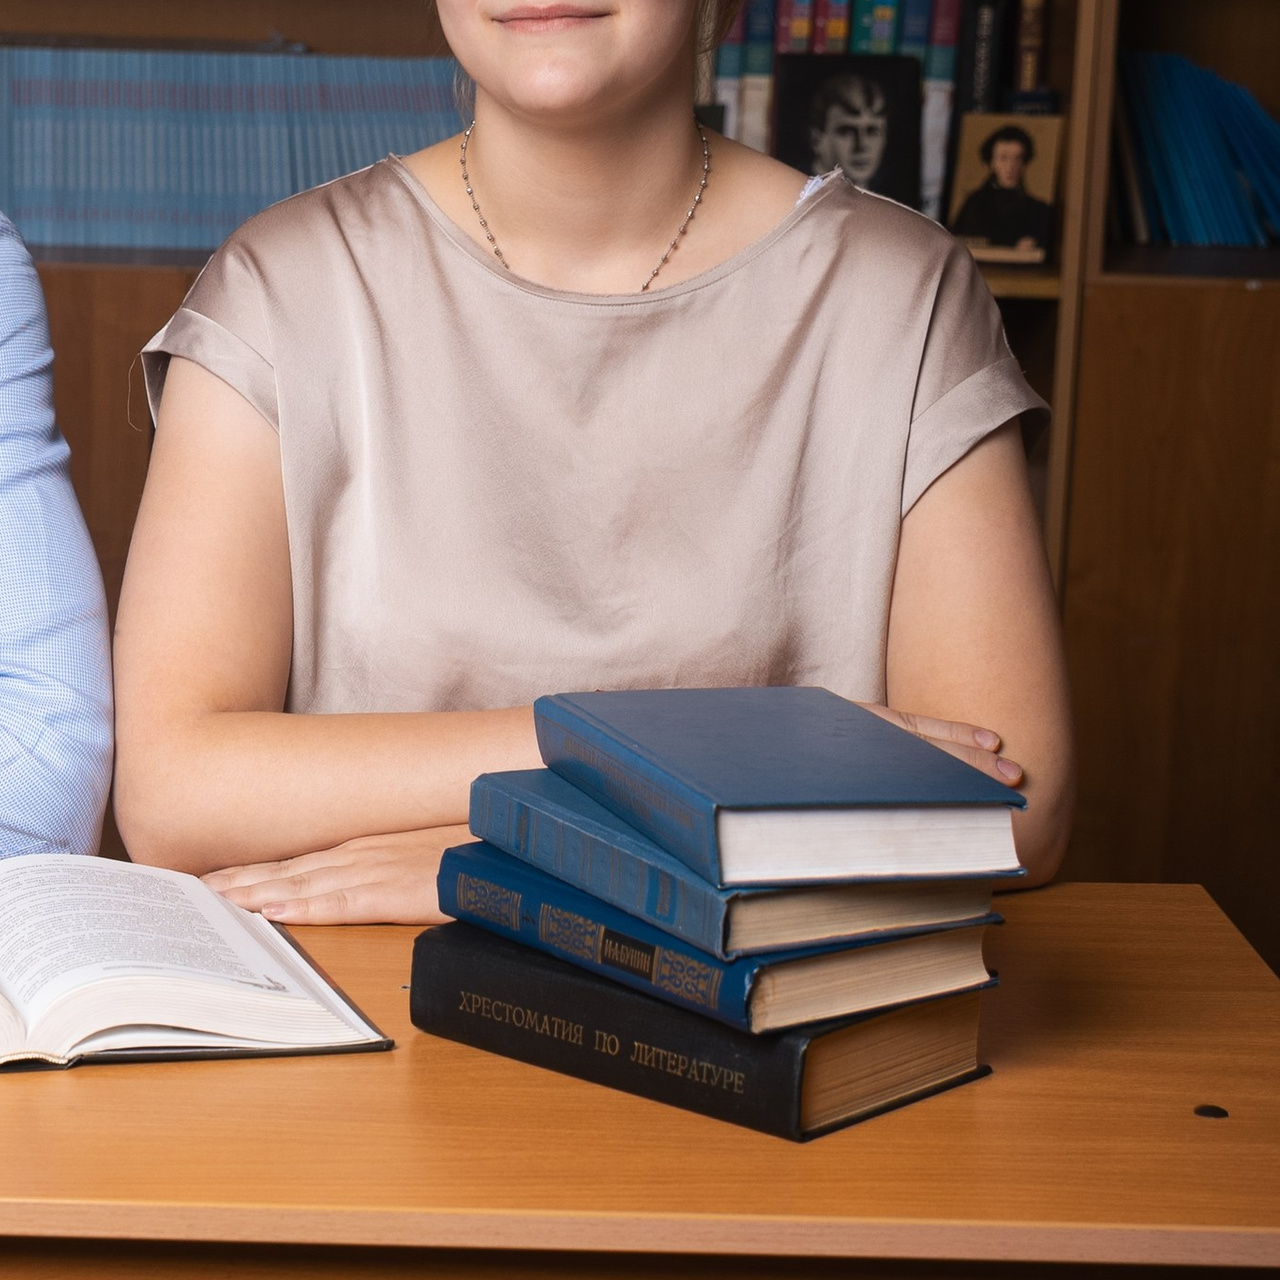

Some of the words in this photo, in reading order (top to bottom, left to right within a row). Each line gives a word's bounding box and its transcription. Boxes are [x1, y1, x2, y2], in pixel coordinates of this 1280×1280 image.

[458, 990, 584, 1045] ХРЕСТОМАТИЯ
[593, 1029, 620, 1056] ПО
[630, 1040, 746, 1094] ЛИТЕРАТУРЕ
